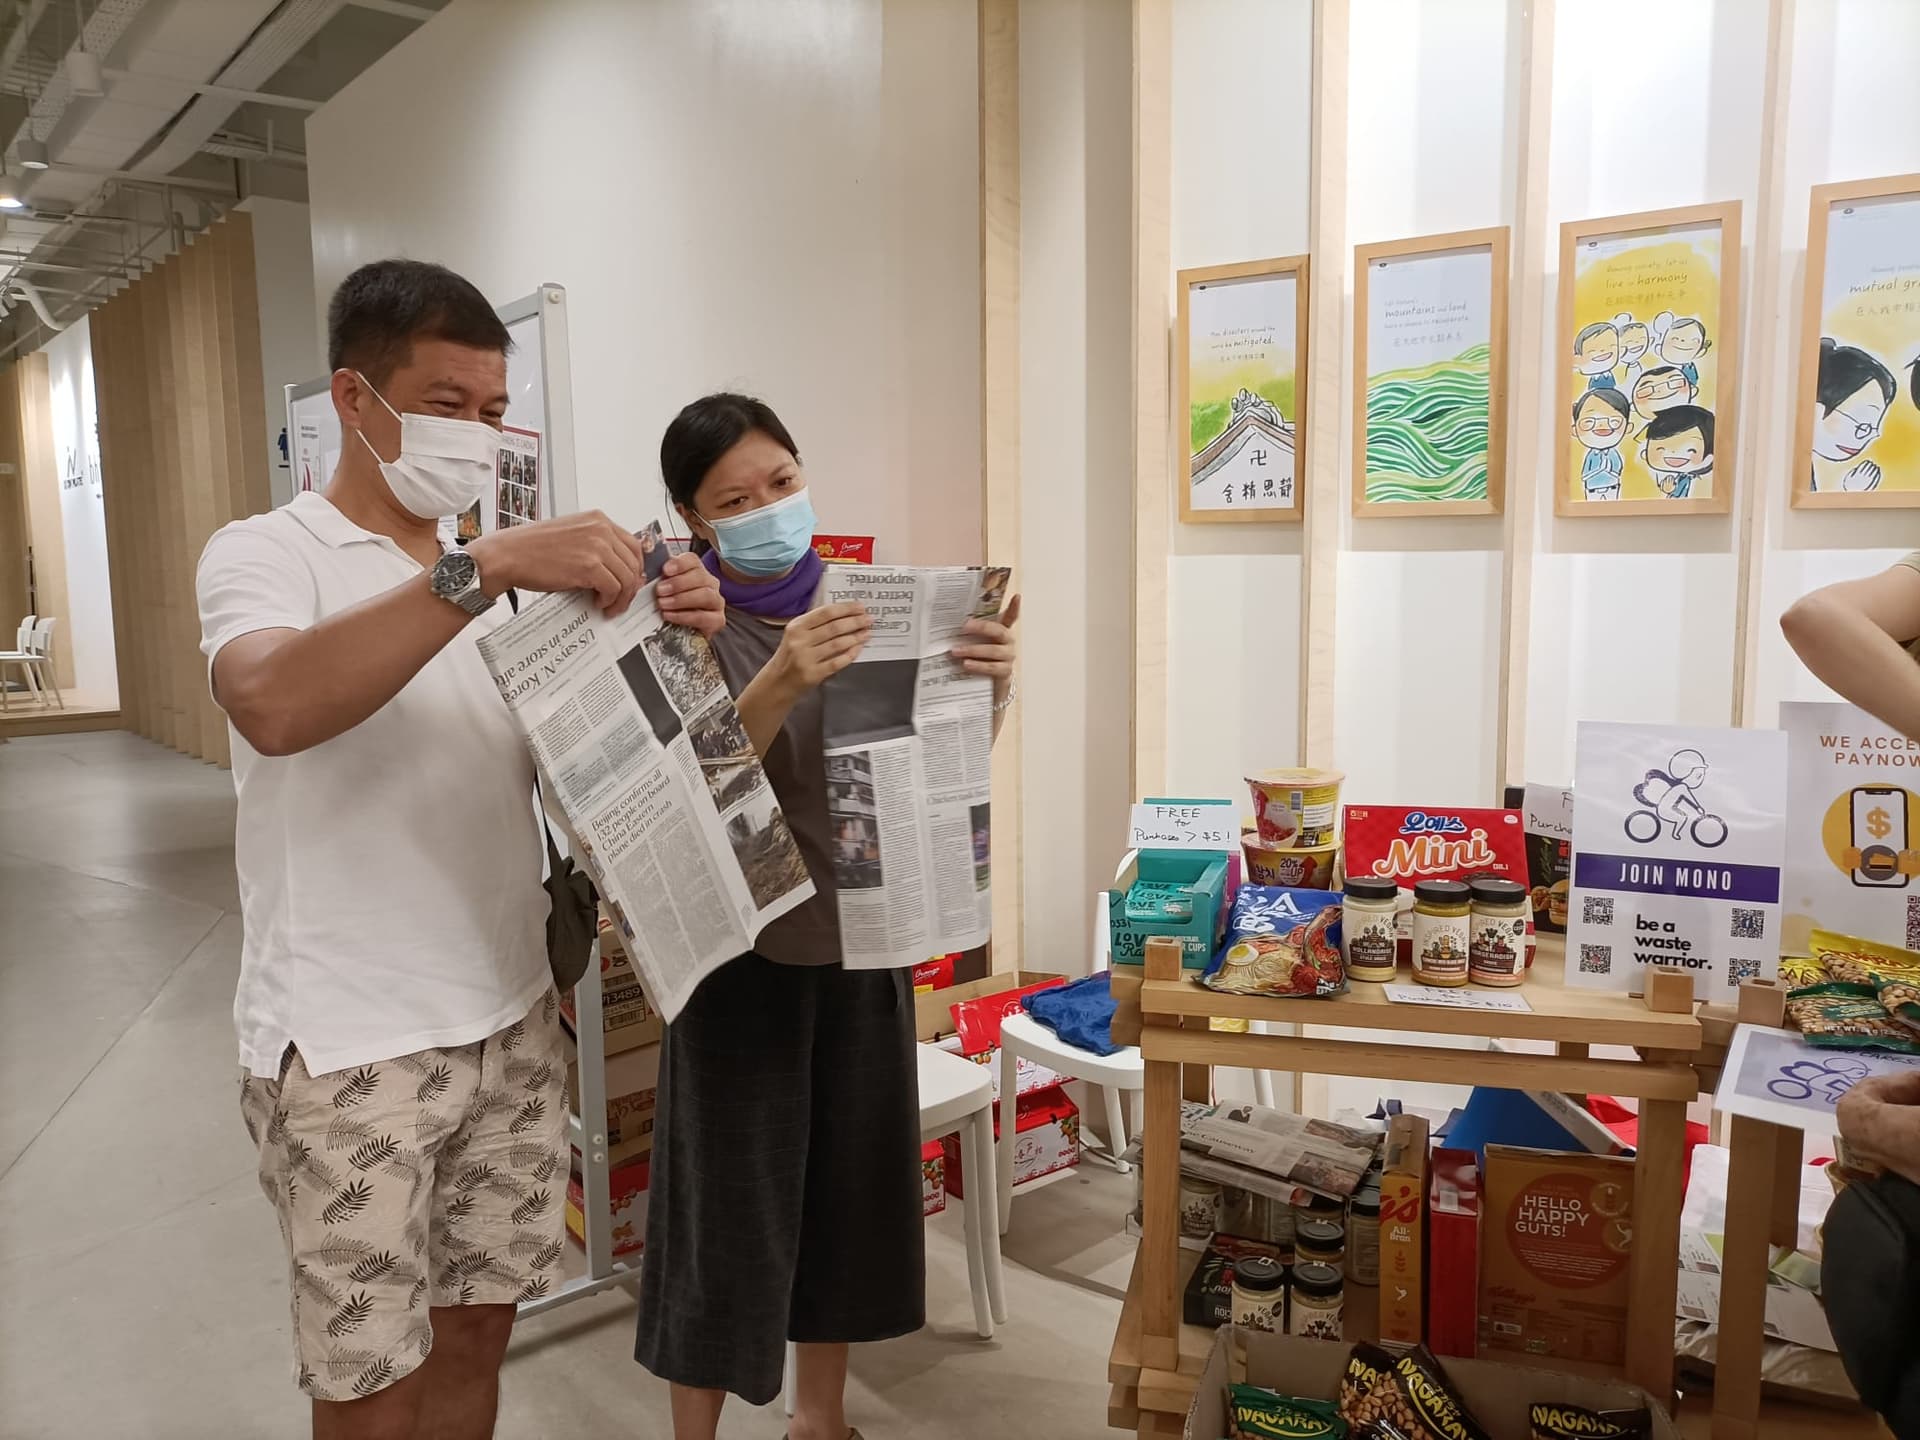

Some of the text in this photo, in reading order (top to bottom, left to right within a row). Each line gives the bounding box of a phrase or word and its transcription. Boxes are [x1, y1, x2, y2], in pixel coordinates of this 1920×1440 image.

[1636, 272, 1688, 285] harmony
[1849, 276, 1898, 294] mutual
[1385, 305, 1435, 319] mountains
[561, 610, 590, 639] more
[548, 634, 562, 647] in
[577, 628, 596, 649] US
[517, 643, 549, 672] store
[502, 672, 541, 703] Korea
[1820, 735, 1920, 751] WE ACCE
[1835, 752, 1920, 768] PAYNOW
[592, 768, 663, 832] Beijing confirms all
[597, 775, 671, 842] 132 people on board
[1156, 806, 1201, 819] FREE
[1400, 811, 1467, 834] 오예스
[602, 804, 655, 852] China Eastern
[607, 839, 629, 865] plane
[629, 822, 646, 843] died
[653, 799, 673, 821] crash
[1530, 812, 1573, 835] Purcha
[1373, 829, 1496, 878] Mini
[1620, 862, 1732, 891] JOIN MONO
[1636, 913, 1675, 933] be a
[1115, 931, 1147, 948] LOV
[1188, 943, 1207, 952] CUPS
[1634, 936, 1692, 952] waste
[1634, 952, 1712, 970] warrior.
[1524, 1194, 1582, 1212] HELLO
[1518, 1206, 1590, 1227] HAPPY
[1515, 1220, 1567, 1238] GUTS!
[1396, 1356, 1474, 1440] NAGARAY
